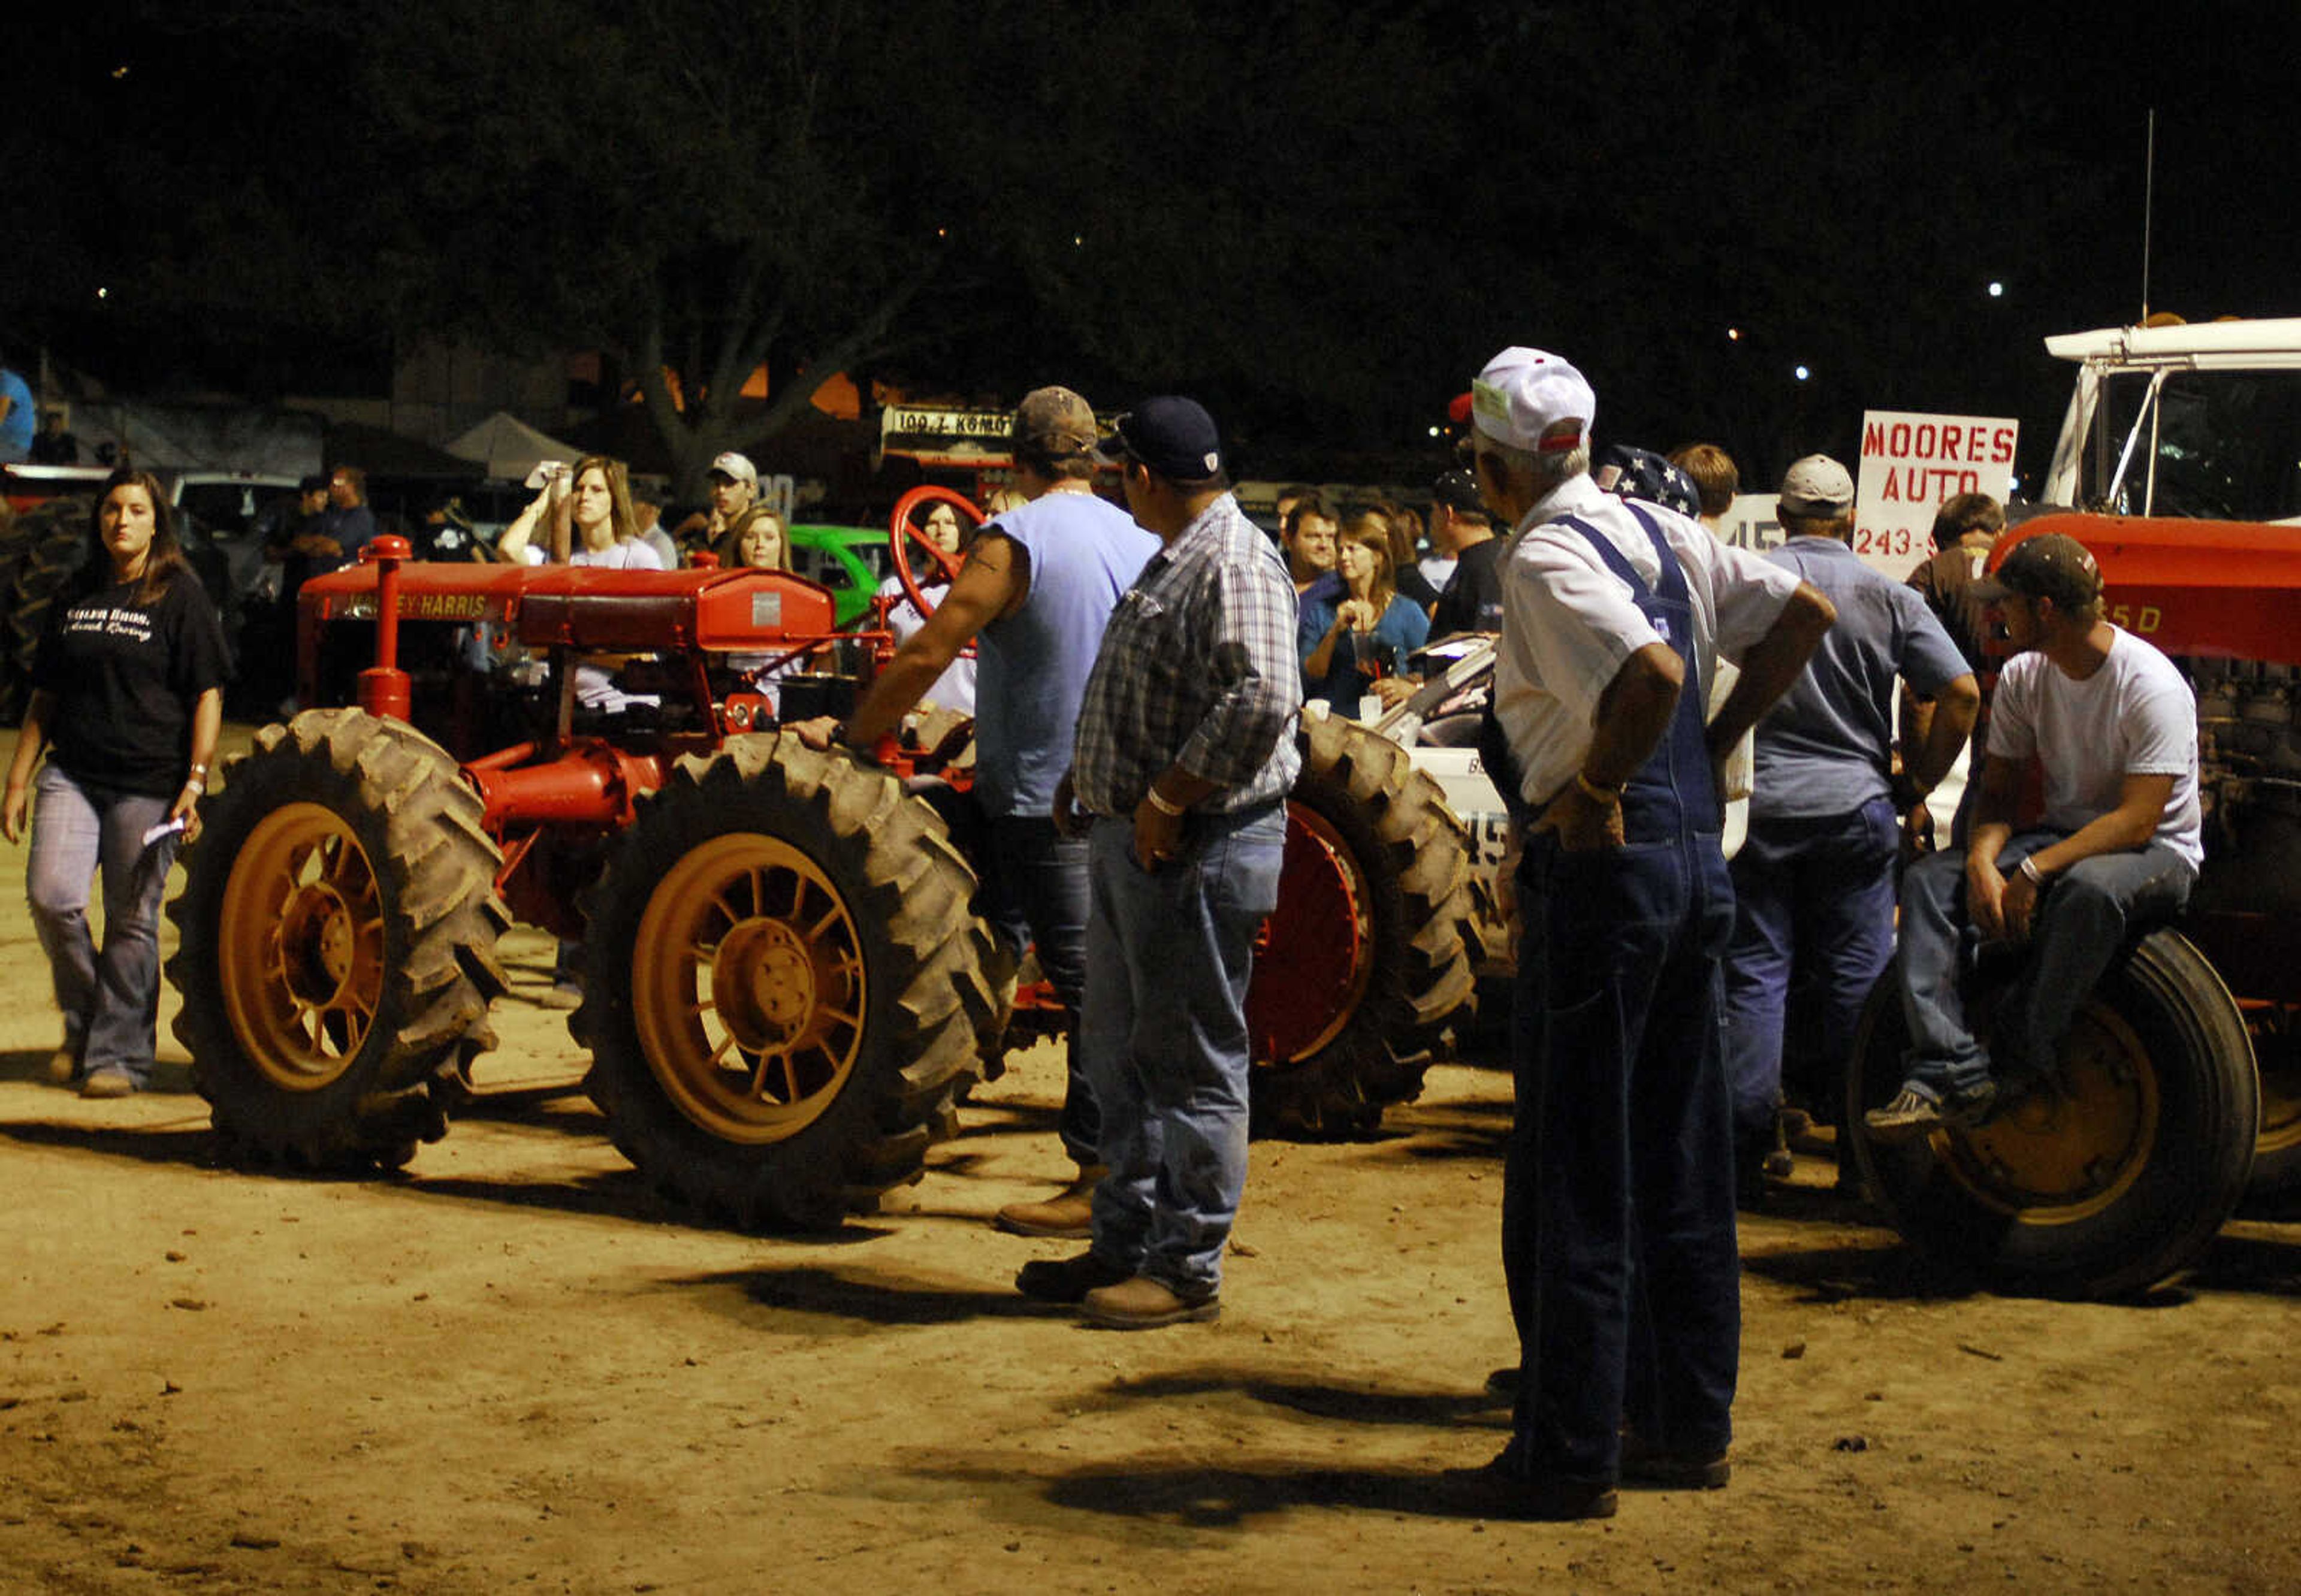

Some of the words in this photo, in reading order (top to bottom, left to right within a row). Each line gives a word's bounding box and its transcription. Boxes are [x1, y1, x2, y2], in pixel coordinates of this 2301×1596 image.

[1863, 421, 2015, 463] MOORES
[1882, 466, 1979, 504] AUTO
[421, 594, 485, 616] HARRIS
